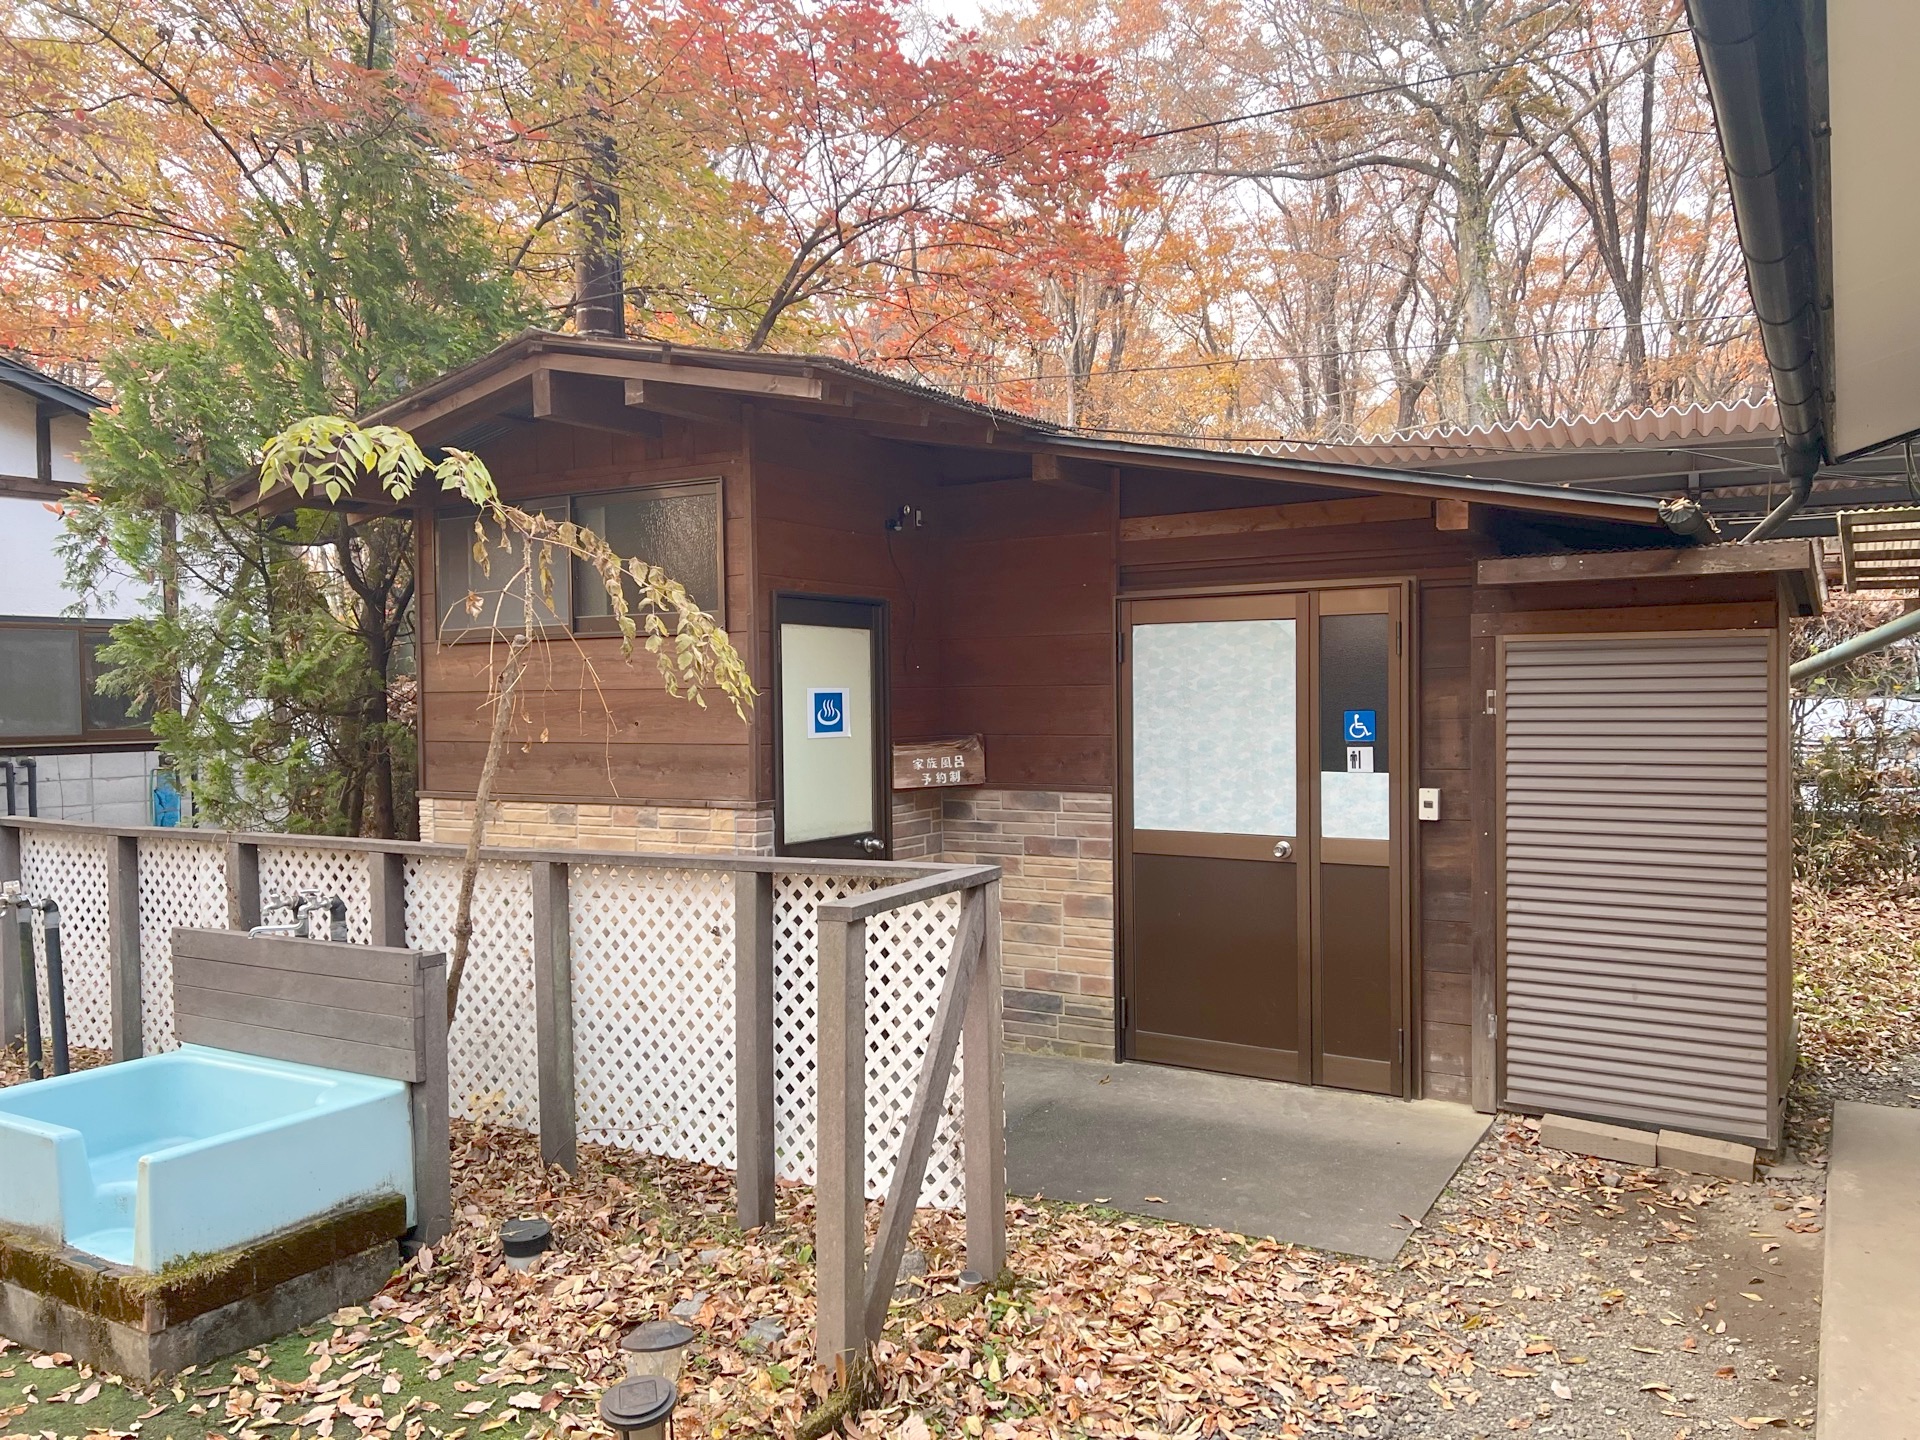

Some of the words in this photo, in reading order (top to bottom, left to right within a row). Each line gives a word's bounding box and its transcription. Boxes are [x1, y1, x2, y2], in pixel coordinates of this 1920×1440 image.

[912, 754, 965, 770] 家族風呂
[921, 770, 961, 786] 予約制
